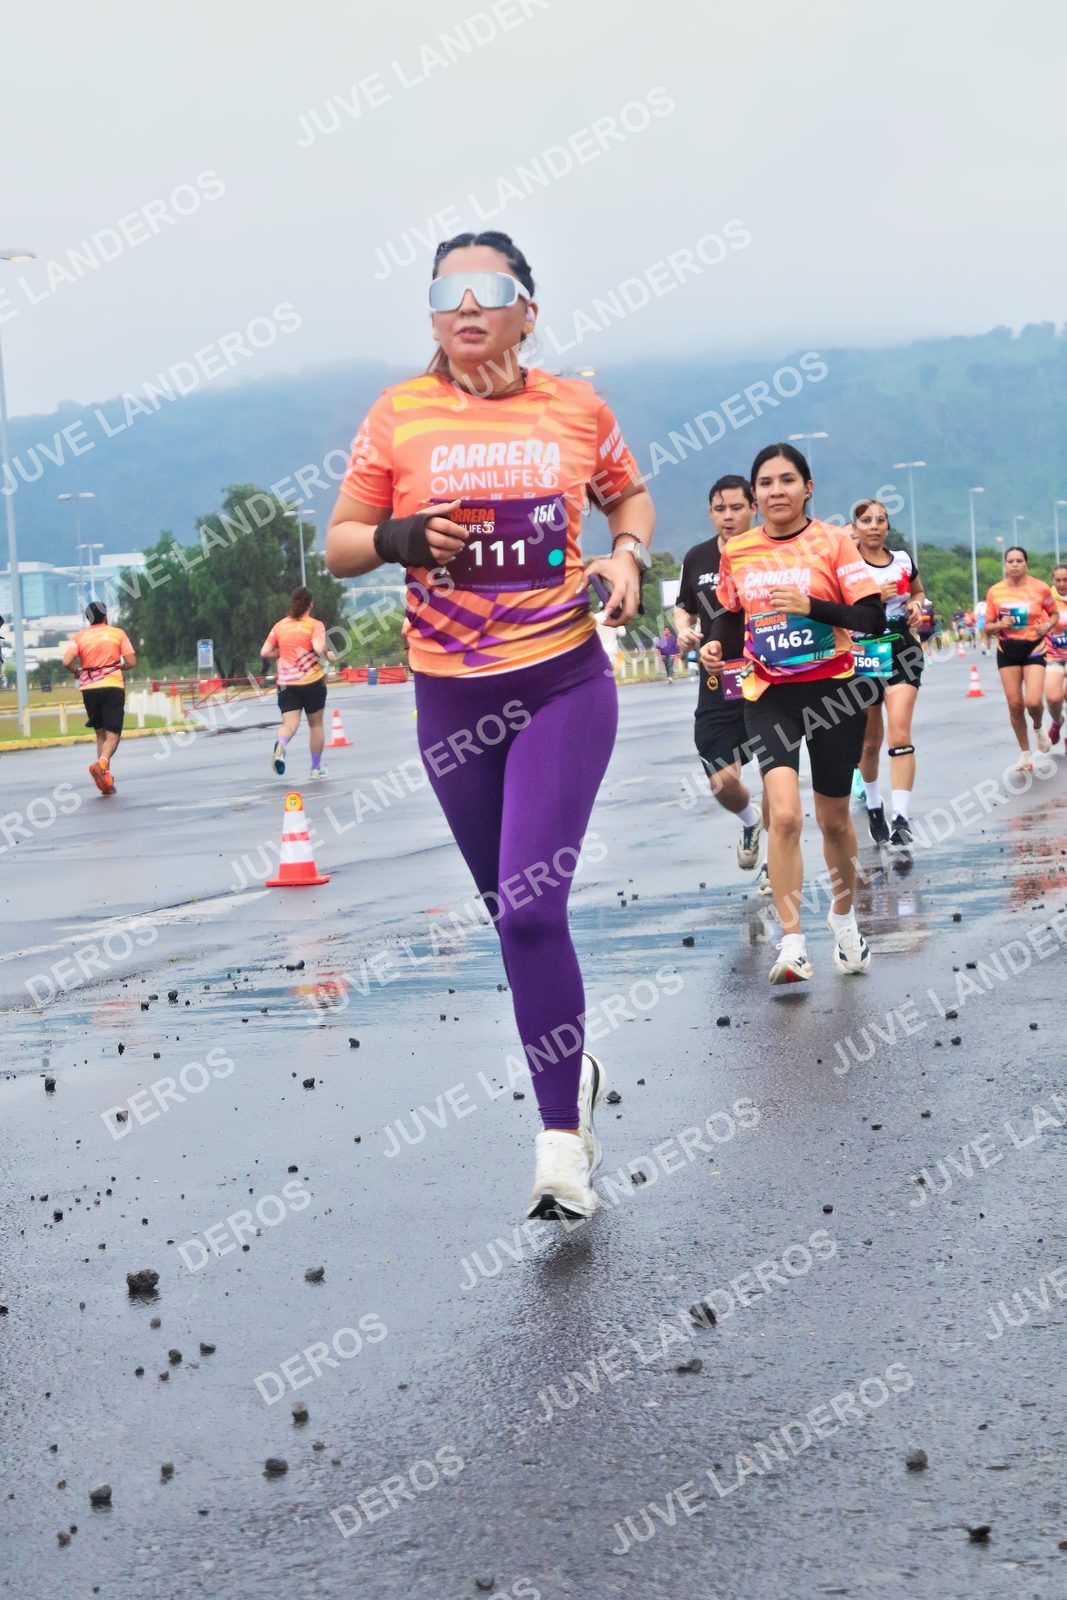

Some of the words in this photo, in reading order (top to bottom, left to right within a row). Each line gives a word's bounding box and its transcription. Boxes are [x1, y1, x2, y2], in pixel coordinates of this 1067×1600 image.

[430, 439, 560, 473] CARRERA
[431, 468, 533, 494] OMNILIFE
[450, 508, 495, 522] RRERA
[533, 503, 557, 523] 15K
[468, 539, 526, 566] 111
[744, 568, 811, 589] CARRERA
[766, 628, 814, 651] 1462
